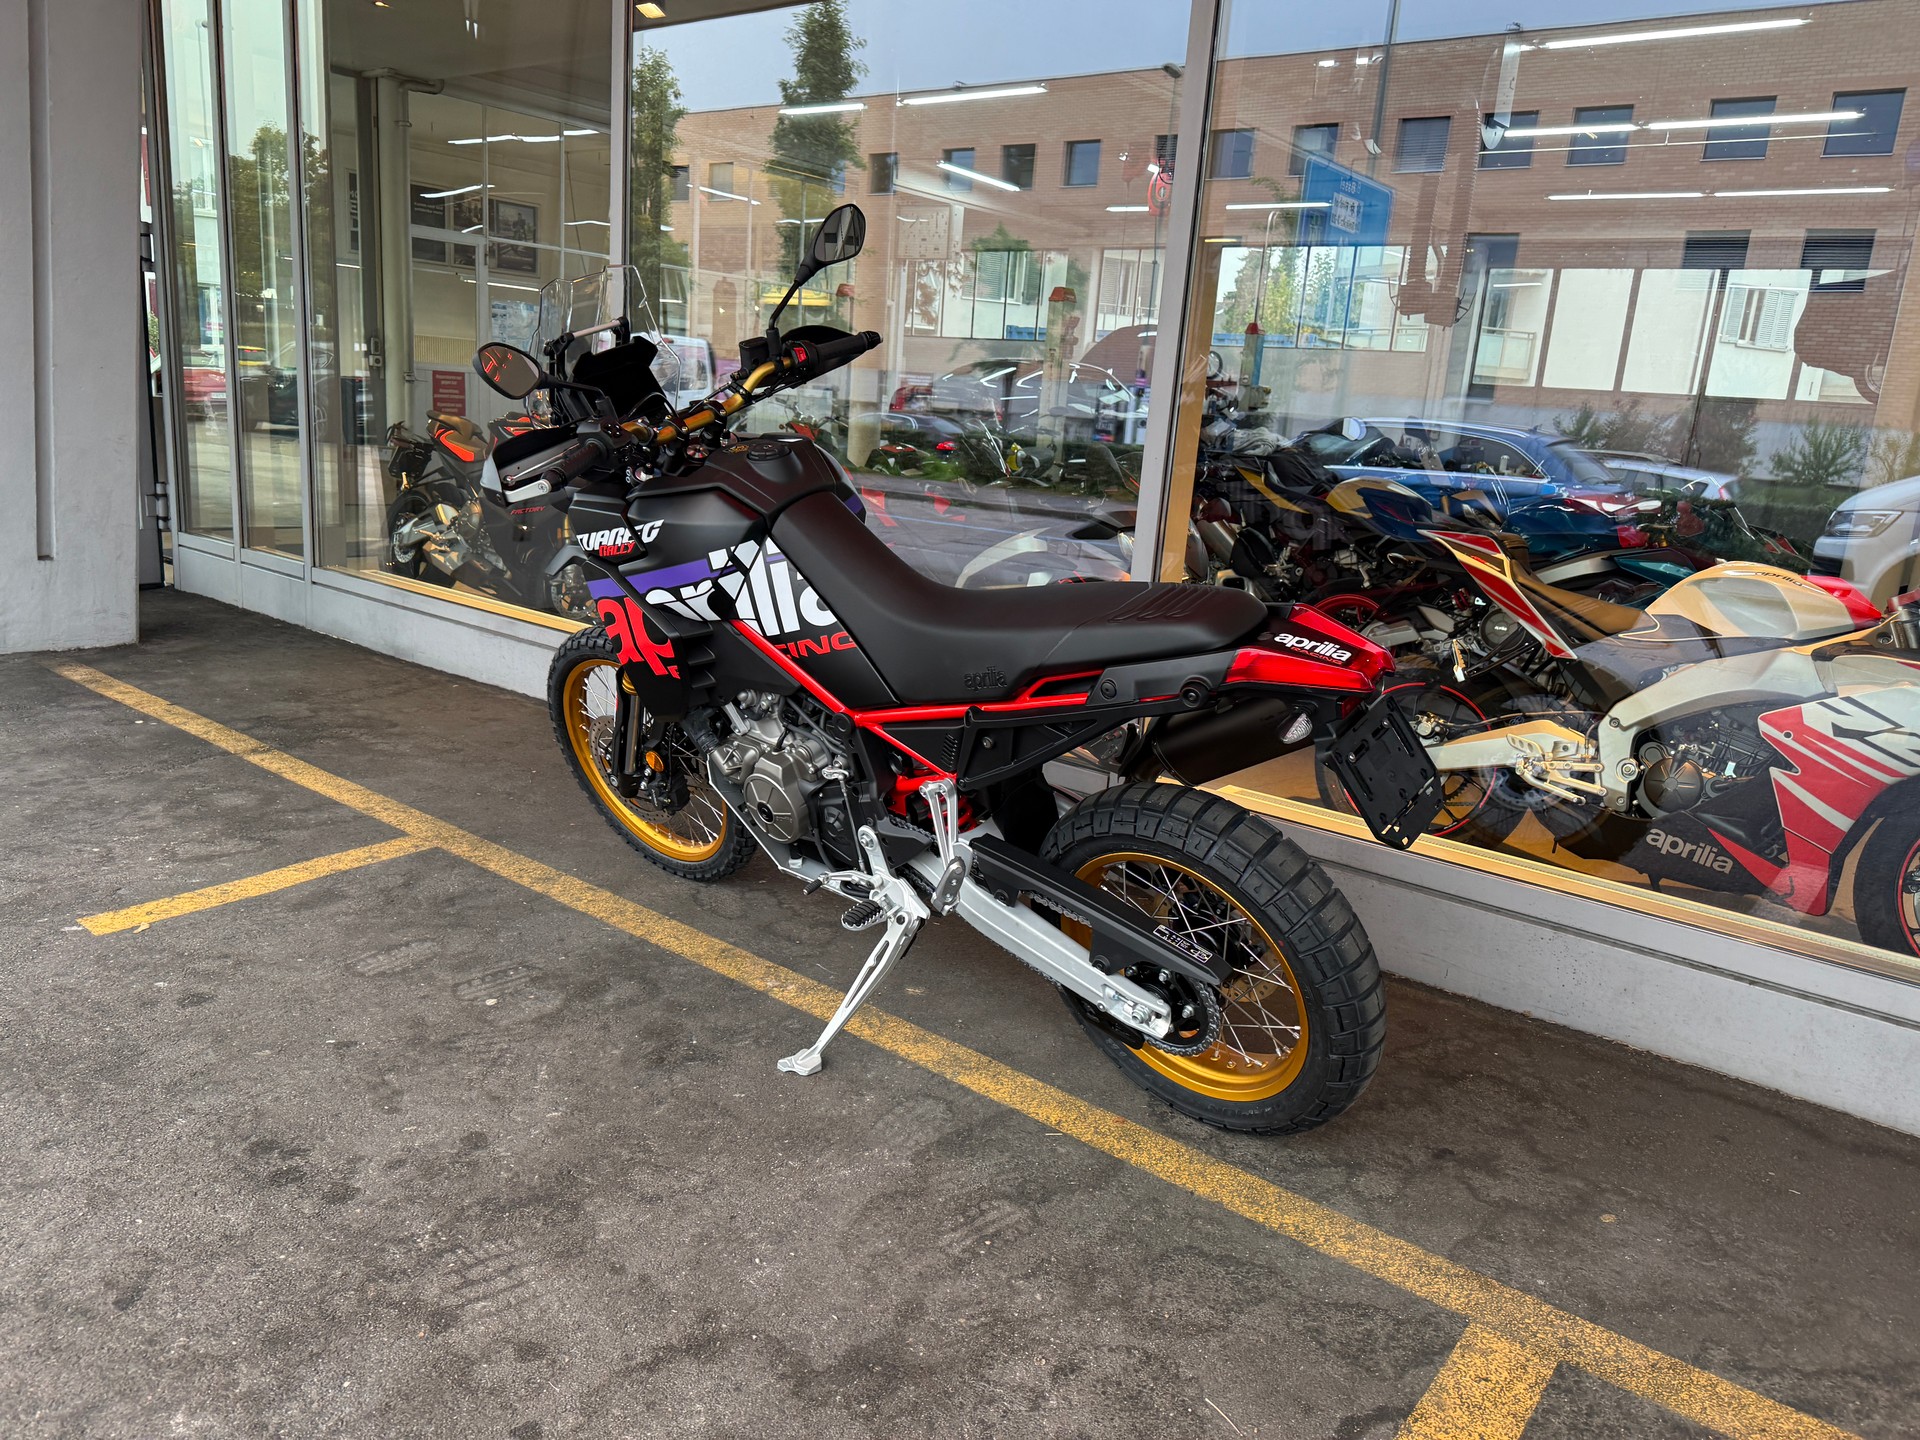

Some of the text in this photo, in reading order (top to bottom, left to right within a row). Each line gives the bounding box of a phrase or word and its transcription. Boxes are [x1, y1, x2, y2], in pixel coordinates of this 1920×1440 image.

[510, 505, 545, 515] FACTORY
[599, 541, 635, 557] RALLY
[1754, 571, 1803, 587] aprilia
[1274, 633, 1352, 662] aprilia
[1290, 646, 1343, 665] RACING
[964, 666, 1008, 691] aprilia
[1645, 828, 1734, 875] aprilia
